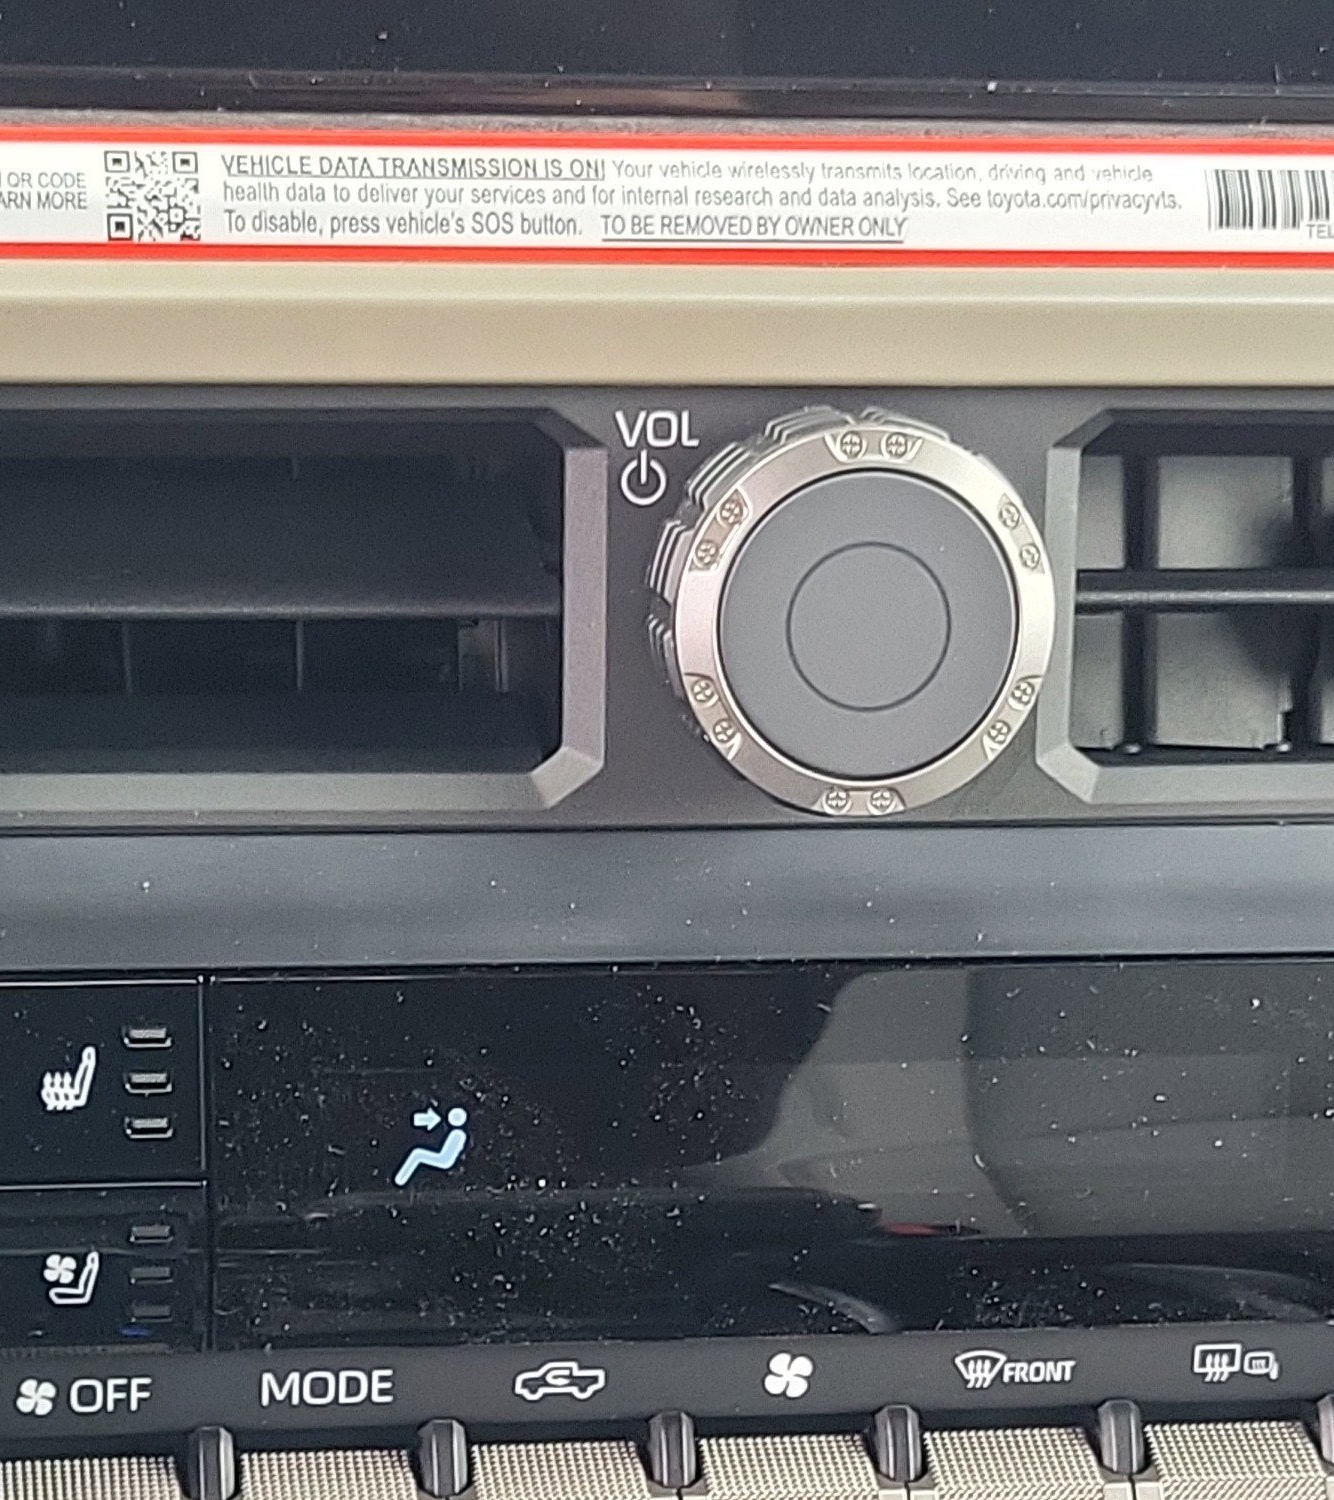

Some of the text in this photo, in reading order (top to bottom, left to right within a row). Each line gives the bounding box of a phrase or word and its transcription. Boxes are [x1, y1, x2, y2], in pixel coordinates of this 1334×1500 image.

[38, 172, 87, 189] CODE
[221, 154, 312, 175] VEHICLE
[319, 156, 374, 177] DATA
[378, 157, 537, 178] TRANSMISSION
[545, 158, 563, 178] IS
[612, 160, 653, 178] Your
[659, 160, 722, 178] vehicle
[728, 161, 815, 185] wirelessly
[821, 162, 902, 180] transmits
[908, 162, 982, 182] location,
[988, 164, 1046, 186] driving
[1053, 164, 1085, 182] and
[1092, 164, 1153, 183] vehicle
[37, 191, 88, 210] MORE
[223, 181, 279, 202] health
[286, 182, 326, 202] data
[333, 183, 350, 203] to
[358, 183, 418, 203] deliver
[424, 187, 464, 209] your
[471, 185, 546, 204] services
[552, 185, 585, 205] and
[592, 185, 616, 205] for
[622, 185, 688, 206] internal
[695, 186, 773, 206] research
[779, 187, 812, 207] and
[818, 187, 856, 207] data
[863, 188, 941, 212] analysis.
[947, 187, 981, 208] See
[224, 209, 909, 240] To disable, press vehicle's SOS button. TO BE REMOVED BY OWNER ONLY
[615, 410, 699, 448] VOL
[1003, 1358, 1075, 1383] FRONT
[70, 1378, 152, 1413] OFF
[260, 1369, 394, 1406] MODE
